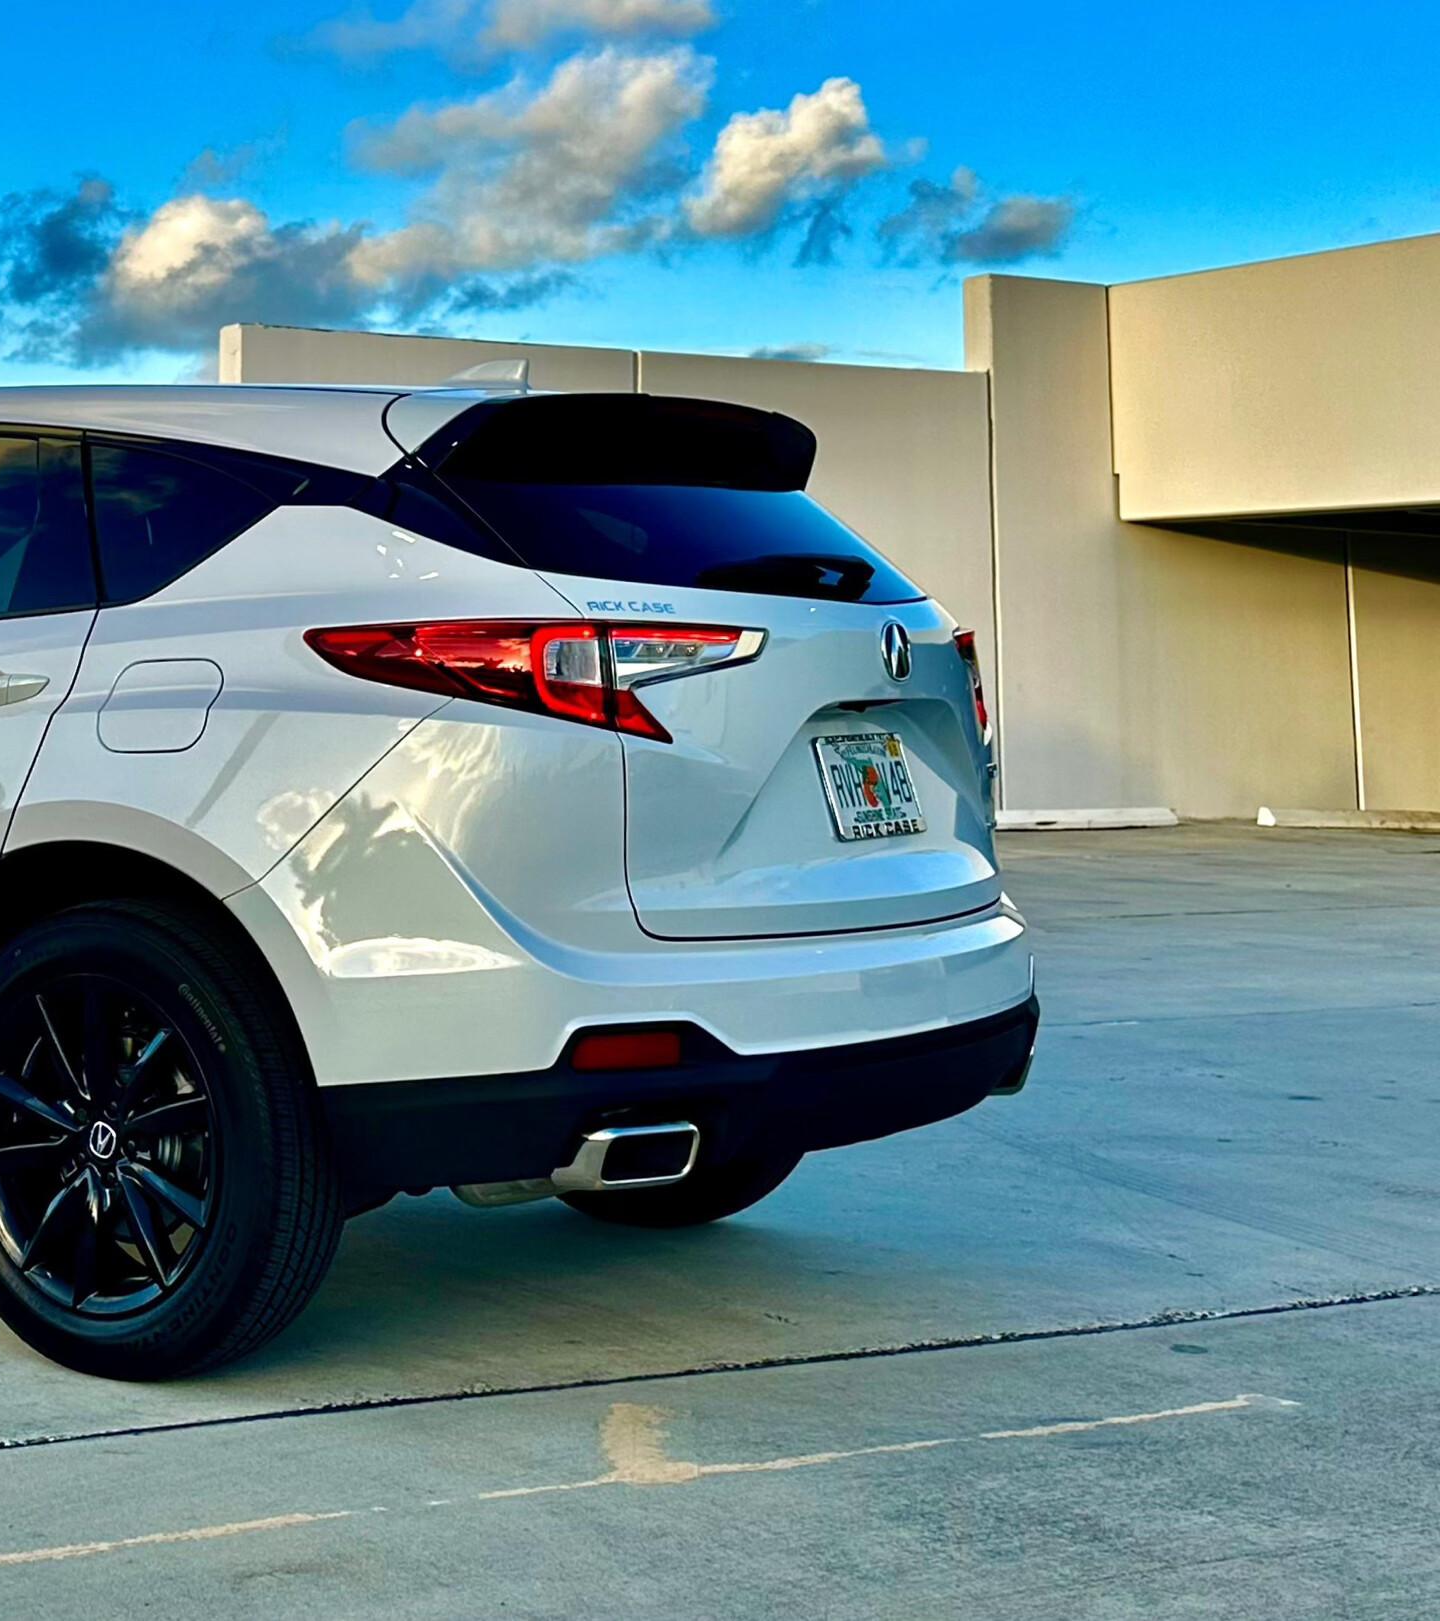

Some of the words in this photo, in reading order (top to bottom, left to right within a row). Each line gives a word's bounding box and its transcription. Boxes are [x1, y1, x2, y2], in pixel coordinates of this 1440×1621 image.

[587, 600, 625, 612] RICK
[628, 601, 676, 614] CASE
[852, 823, 885, 839] RICK
[884, 818, 920, 836] CASE
